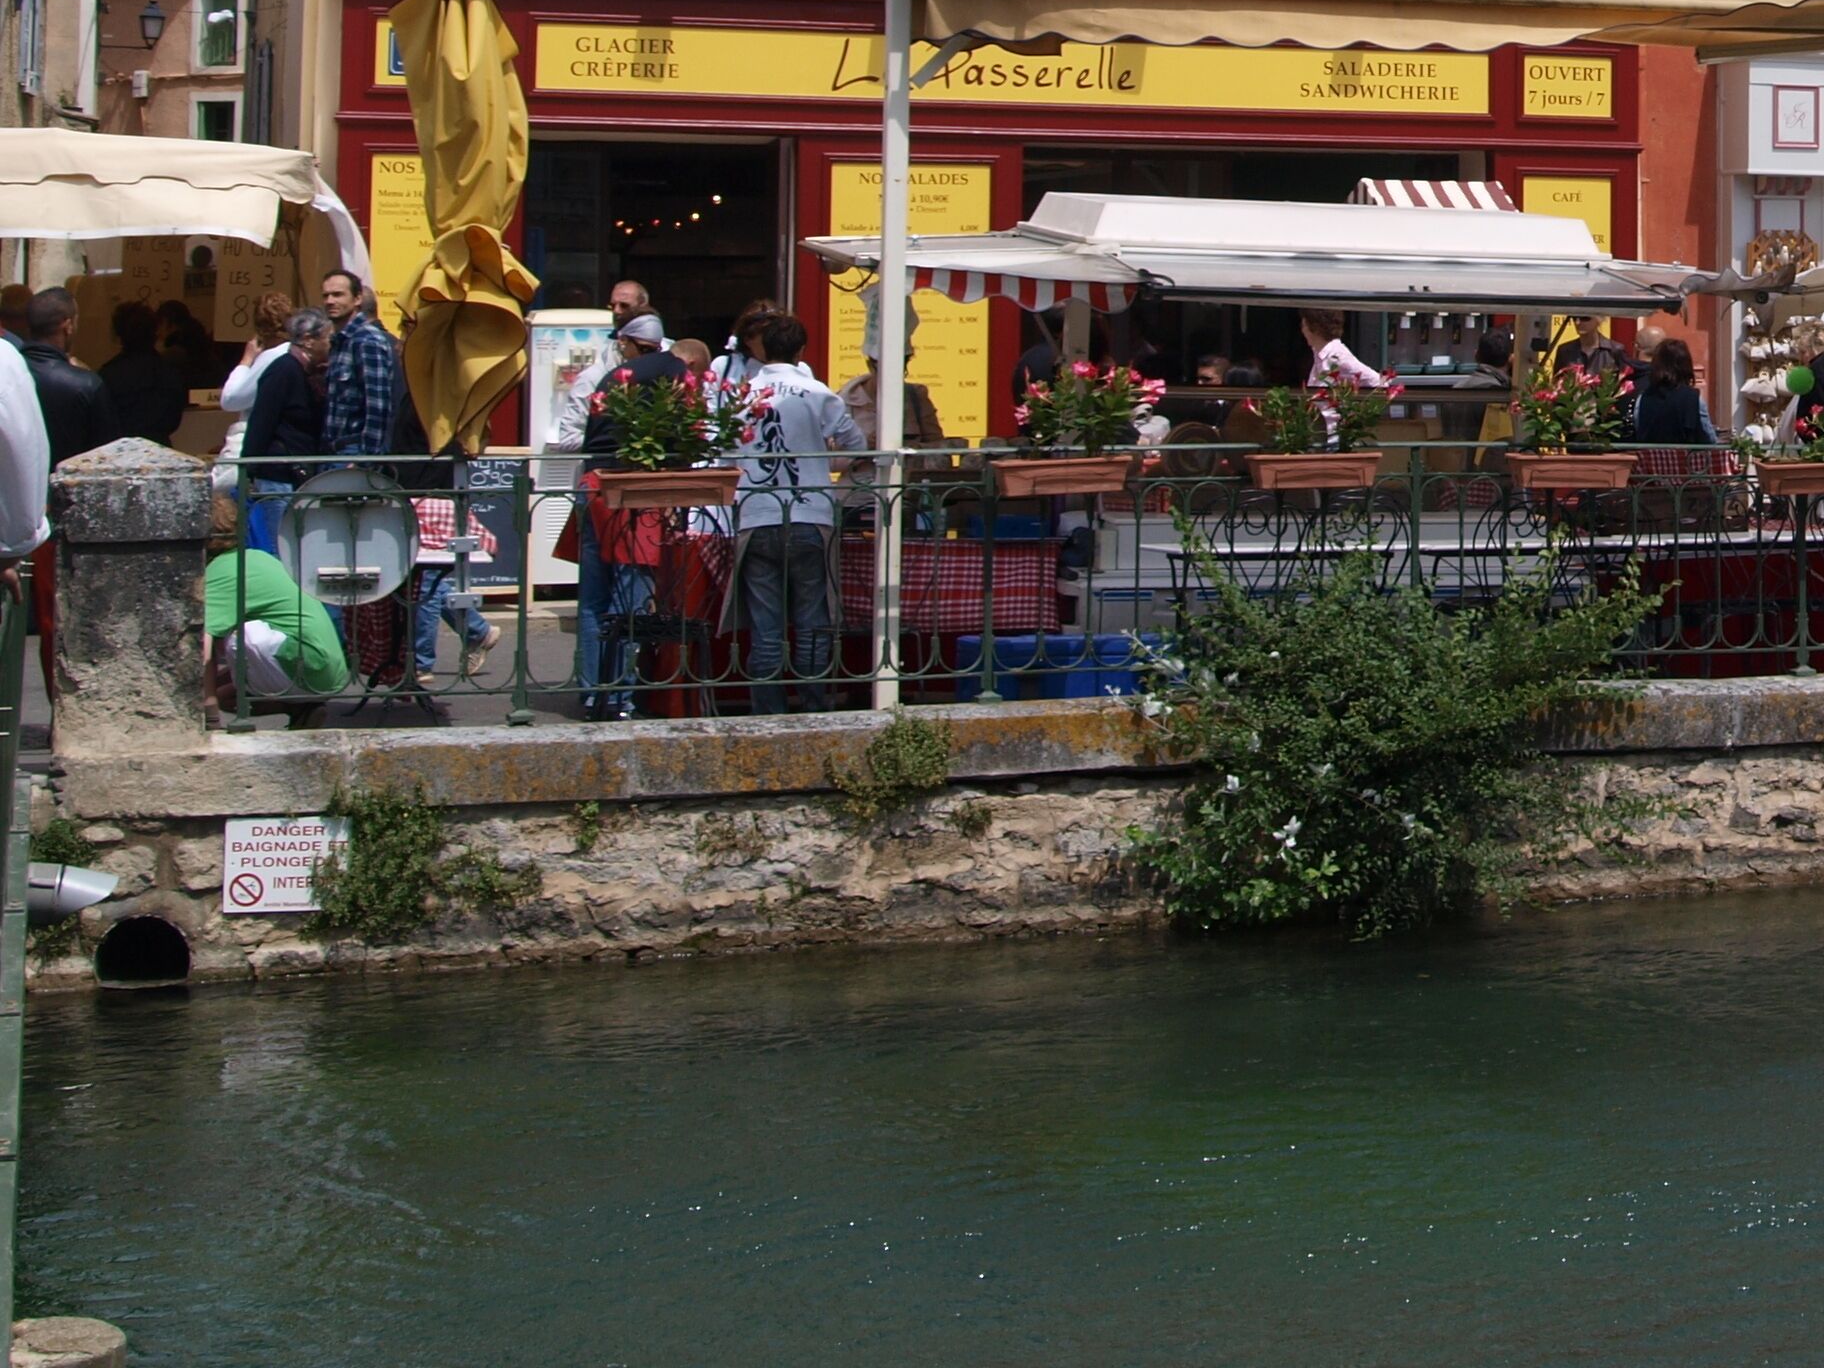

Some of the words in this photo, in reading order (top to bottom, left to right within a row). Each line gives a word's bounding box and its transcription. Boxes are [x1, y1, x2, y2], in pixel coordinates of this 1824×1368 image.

[575, 36, 675, 54] GLACIER
[570, 57, 680, 79] CRÊPERIE
[1323, 61, 1437, 78] SALADERIE
[1529, 65, 1605, 82] OUVERT
[1300, 83, 1460, 101] SANDWICHERIE
[1528, 90, 1537, 103] 7
[1541, 90, 1582, 109] jours
[1586, 90, 1593, 105] /
[1597, 92, 1605, 106] 7
[379, 161, 416, 174] NOS
[859, 172, 882, 185] NO
[907, 173, 969, 186] ALADES
[1552, 190, 1583, 202] CAFÉ
[229, 271, 250, 285] LES
[261, 265, 275, 287] 3
[251, 825, 325, 837] DANGER
[232, 841, 322, 852] BAIGNADE
[328, 840, 349, 852] ET
[240, 856, 340, 867] PLONGEO
